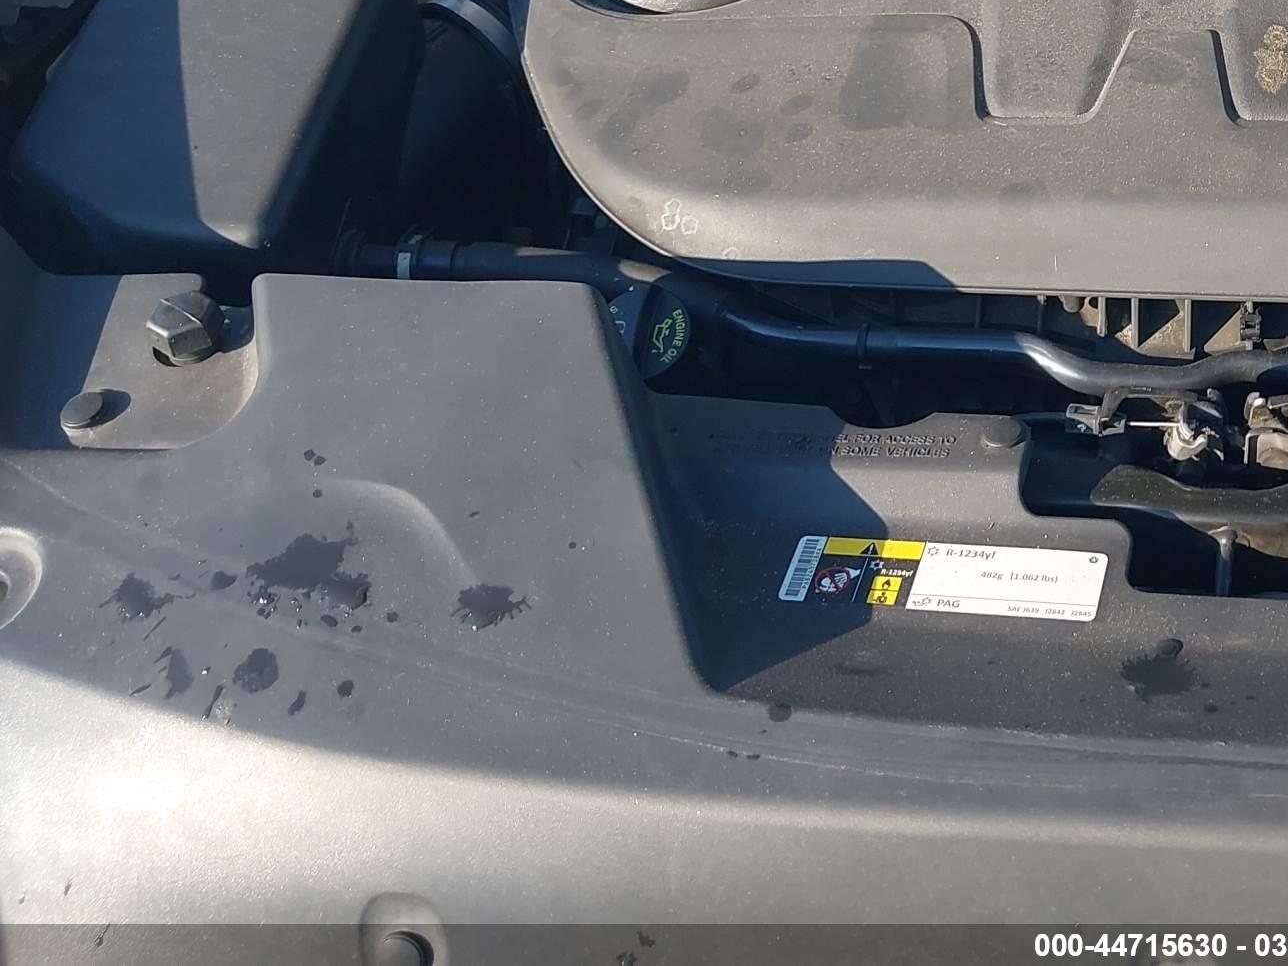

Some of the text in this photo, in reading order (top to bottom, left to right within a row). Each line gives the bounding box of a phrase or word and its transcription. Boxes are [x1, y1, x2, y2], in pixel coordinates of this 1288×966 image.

[659, 309, 686, 364] ENGINE OIL
[854, 434, 880, 444] FOR
[882, 435, 936, 445] ACCESS
[939, 436, 958, 445] TO
[840, 445, 880, 456] SOME
[886, 447, 951, 458] VEHICLES
[946, 548, 996, 560] R-1234yf
[880, 568, 914, 577] R-1234yf
[936, 598, 961, 607] PAG
